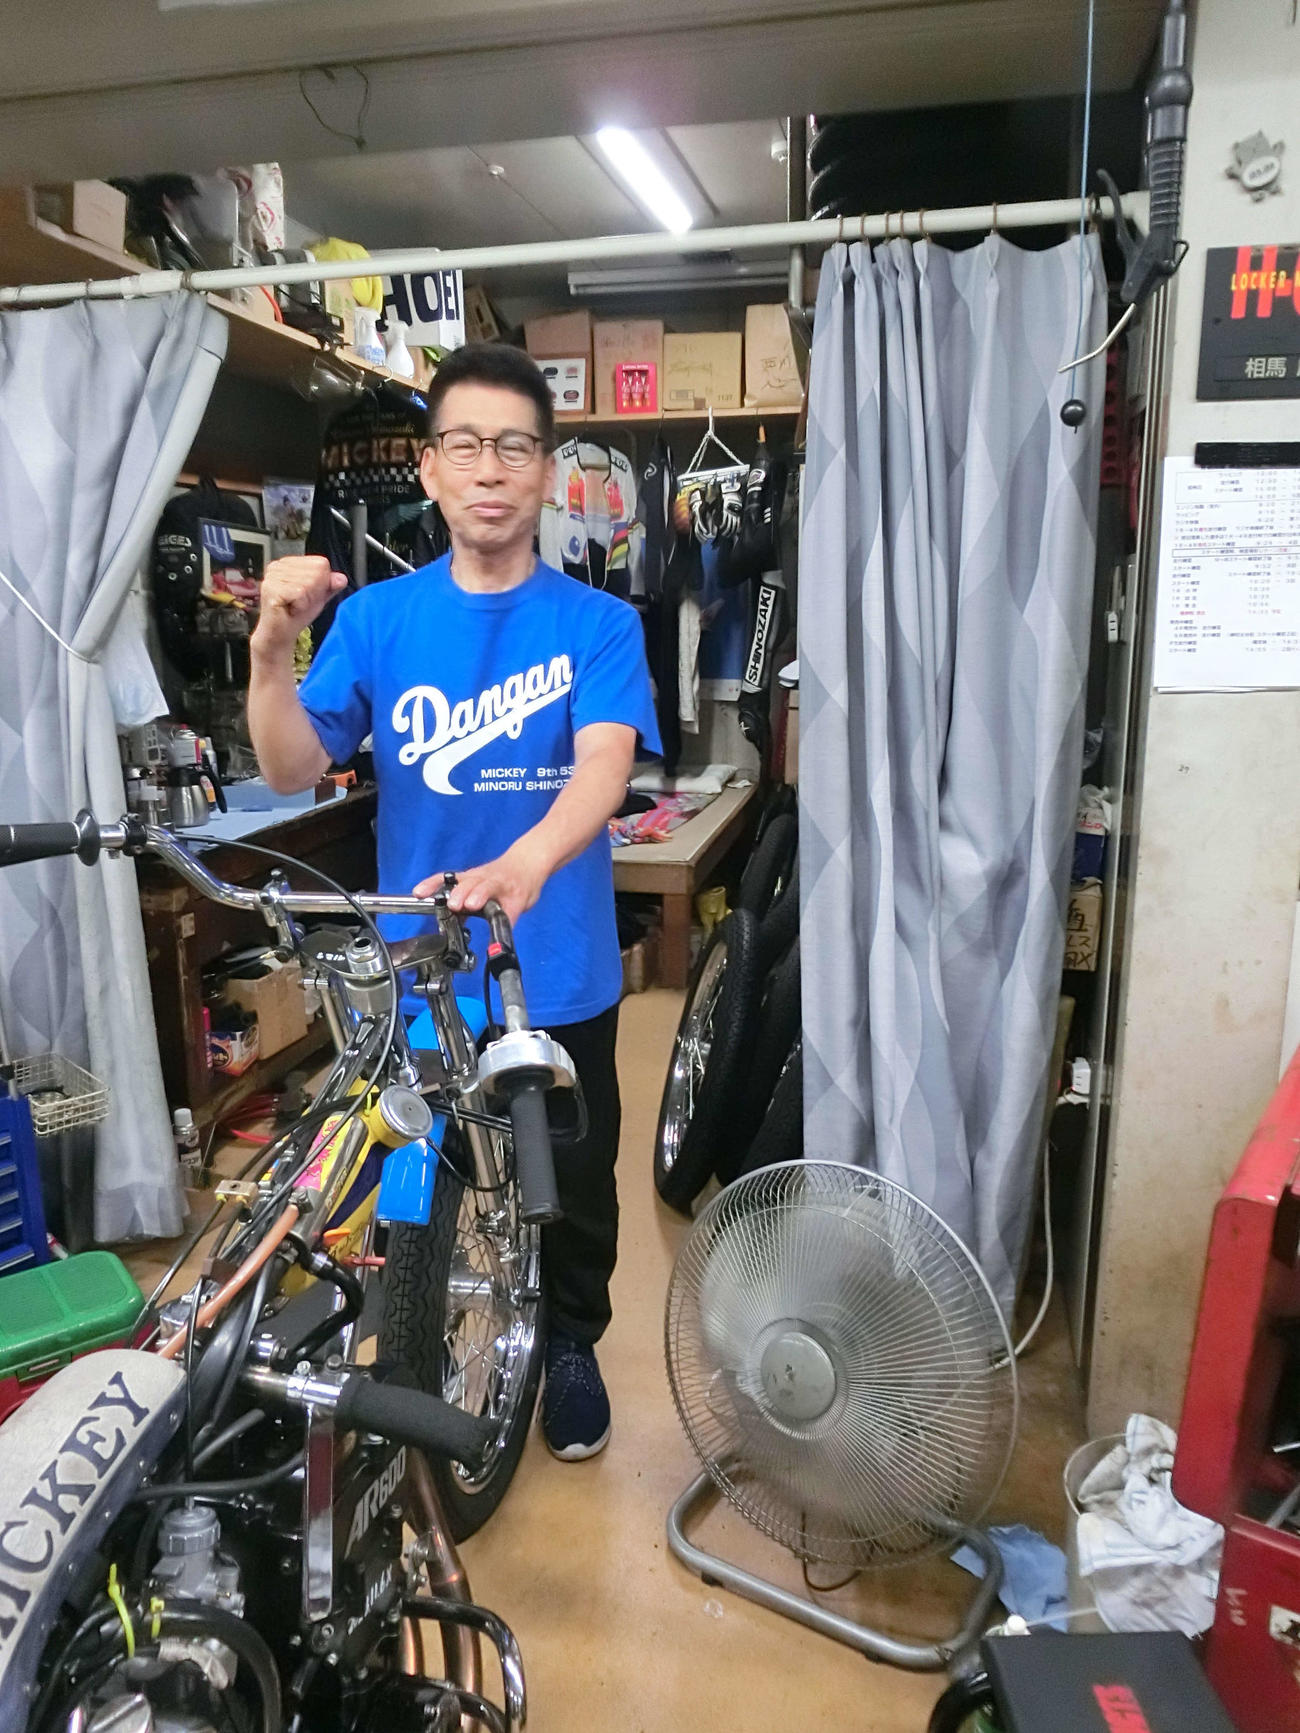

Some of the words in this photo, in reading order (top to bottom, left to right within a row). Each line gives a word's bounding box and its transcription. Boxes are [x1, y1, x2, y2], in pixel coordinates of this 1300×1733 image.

[1230, 270, 1287, 291] LOCKER
[1245, 357, 1287, 379] 相馬
[748, 588, 772, 683] SHINOZAKI
[392, 654, 573, 766] Dangan
[474, 782, 522, 792] MINORU
[481, 768, 527, 778] MICKEY
[537, 767, 558, 777] 9th
[0, 1371, 149, 1645] ICKEY
[344, 1445, 407, 1560] AR600
